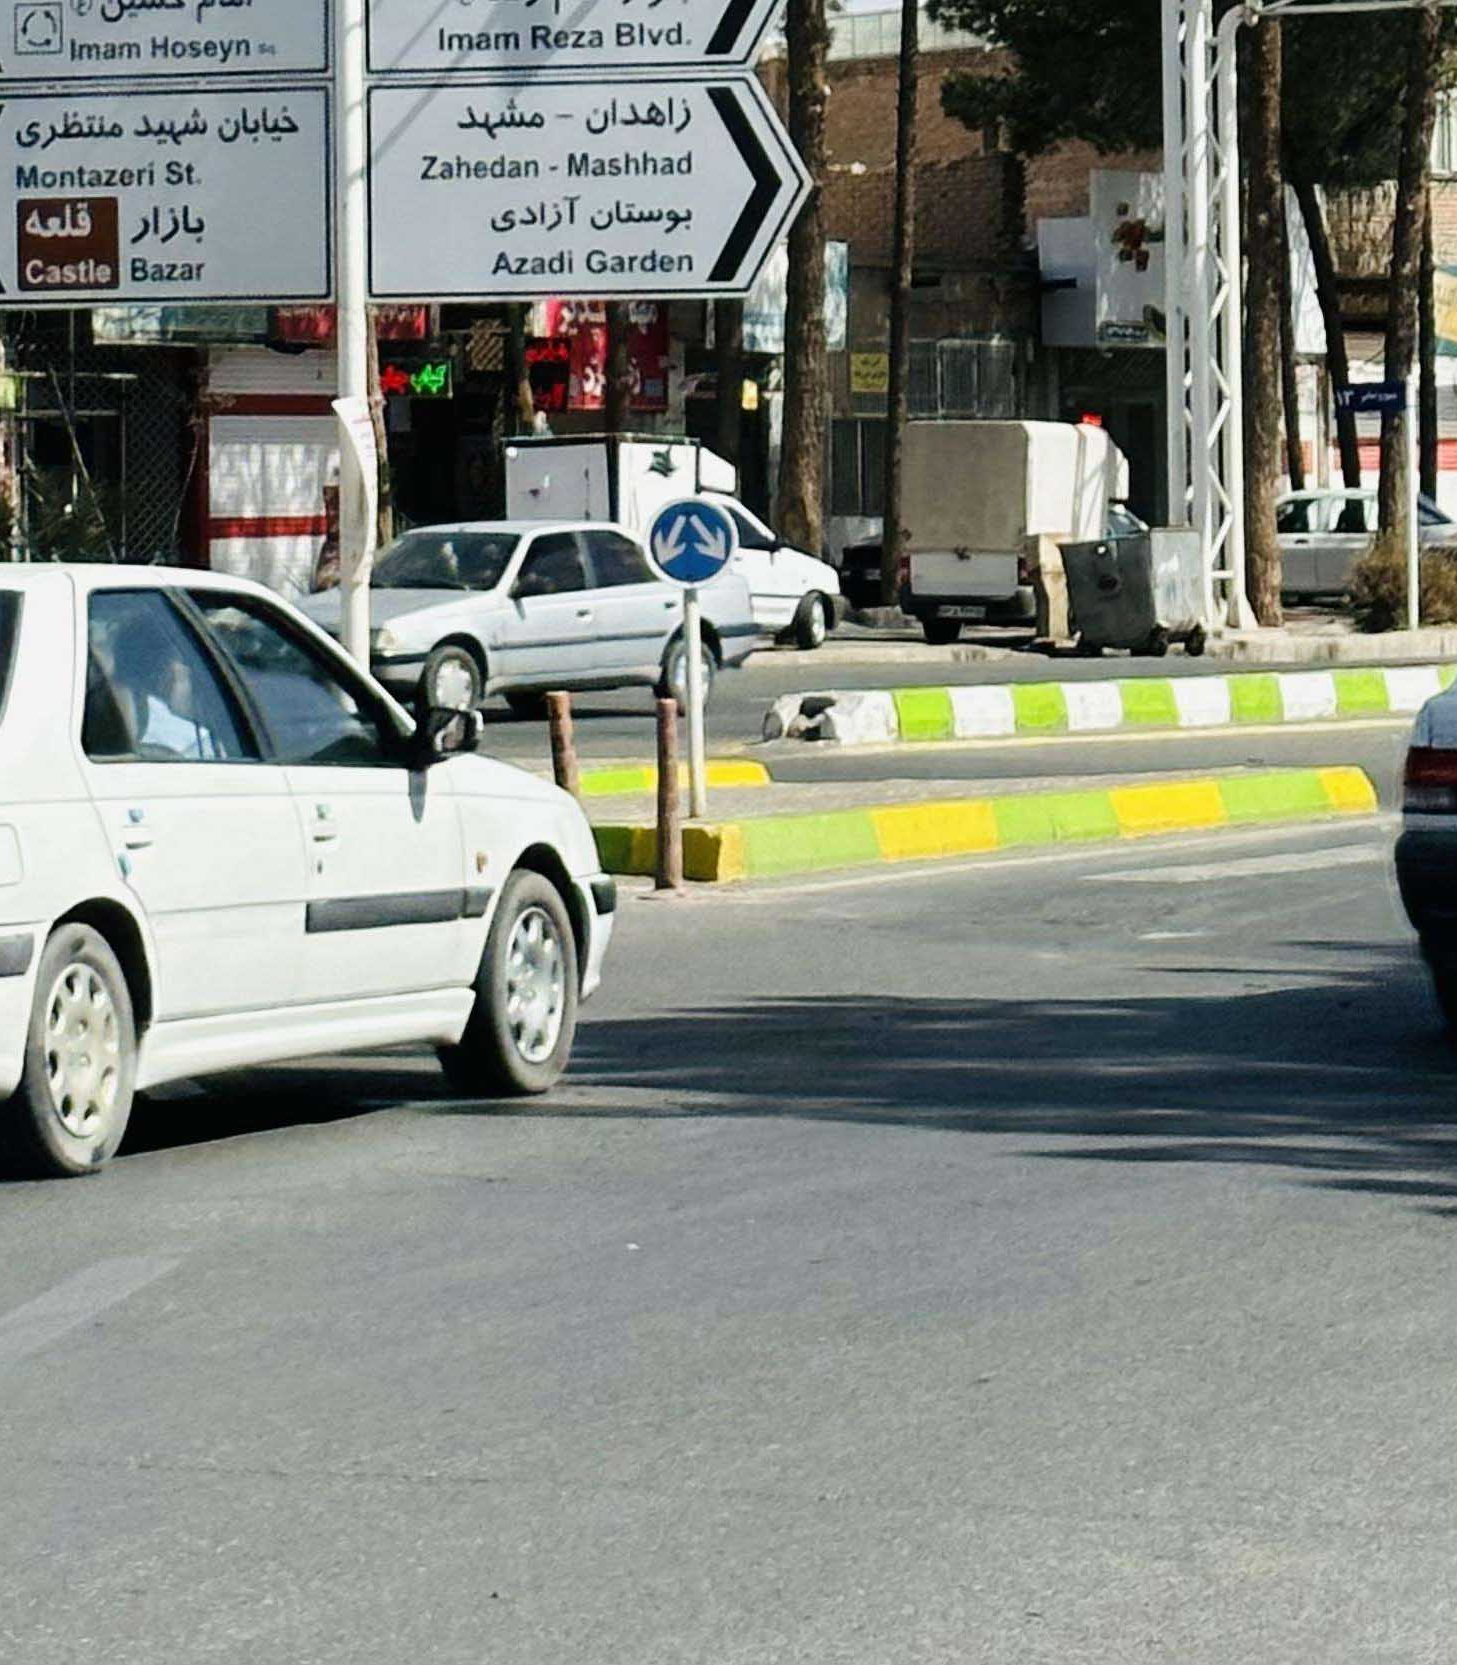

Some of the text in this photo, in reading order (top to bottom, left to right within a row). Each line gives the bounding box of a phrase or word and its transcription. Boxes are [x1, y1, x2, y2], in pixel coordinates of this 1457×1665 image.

[71, 37, 141, 61] Imam
[150, 36, 251, 63] Hoseyn
[439, 22, 691, 52] Imam Reza Blvd.
[15, 106, 299, 148] خیابان شهید منتظری
[457, 97, 544, 139] مشهد
[586, 98, 691, 135] زاهدان
[15, 161, 201, 190] Montazeri St.
[421, 155, 539, 181] Zahedan
[567, 151, 692, 177] Mashhad
[25, 200, 205, 244] بازار قلعه
[490, 195, 692, 233] بوستان آزادی
[25, 258, 205, 284] Castle Bazar
[491, 249, 694, 276] Azadi Garden
